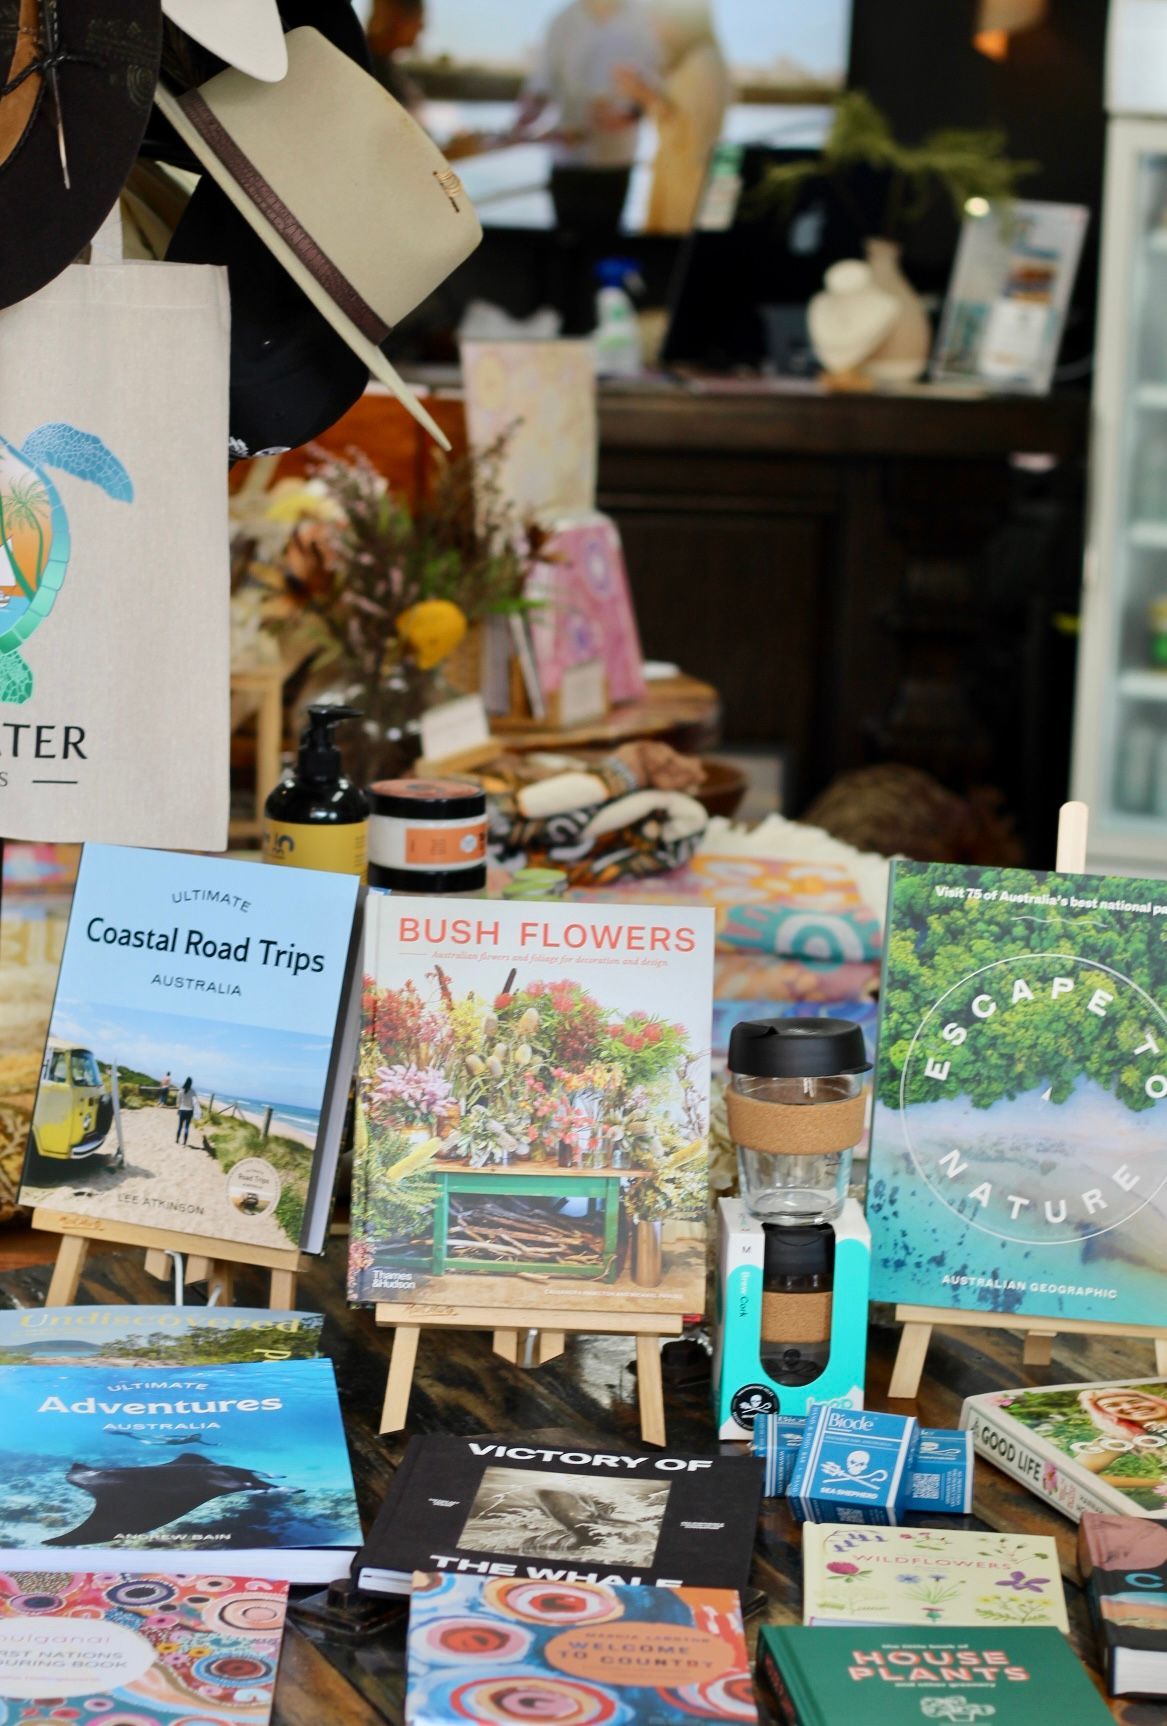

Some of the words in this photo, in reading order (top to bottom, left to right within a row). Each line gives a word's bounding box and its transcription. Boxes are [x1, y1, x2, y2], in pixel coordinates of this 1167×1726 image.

[0, 722, 88, 760] TER
[172, 889, 251, 913] ULTIMATE
[935, 886, 964, 898] Visit
[966, 888, 982, 899] 75
[983, 889, 998, 901] of
[999, 890, 1068, 907] Australia's
[1070, 895, 1097, 908] best
[1099, 900, 1152, 914] national
[399, 917, 499, 945] BUSH
[520, 922, 696, 952] FLOWERS
[87, 917, 178, 952] Coastal
[184, 930, 250, 962] Road
[259, 939, 325, 976] Trips
[151, 974, 242, 996] AUSTRALIA
[925, 977, 1114, 1080] ESCAPE
[1133, 1033, 1167, 1098] TO
[939, 1149, 1140, 1223] NATURE
[142, 1198, 204, 1214] ATKINSON
[372, 1270, 413, 1280] Thames
[942, 1275, 1025, 1291] AUSTRALIAN
[1030, 1283, 1118, 1299] GEOGRAPHIC
[20, 1312, 301, 1333] Undiscovered
[107, 1382, 209, 1392] ULTIMATE
[37, 1396, 283, 1414] Adventures
[103, 1422, 221, 1430] AUSTRALIA
[467, 1443, 648, 1469] VICTORY
[654, 1458, 713, 1472] OF
[982, 1426, 1015, 1462] GOOD
[1018, 1451, 1041, 1481] LIFE
[429, 1555, 518, 1577] THE
[853, 1554, 1013, 1570] WILDFLOWERS
[38, 1651, 124, 1659] NATIONS
[568, 1641, 689, 1655] WELCOME
[852, 1651, 1010, 1665] HOUSE
[71, 1661, 128, 1669] BOOK
[559, 1651, 588, 1660] TO
[600, 1656, 714, 1668] COUNTRY
[848, 1666, 1030, 1681] PLANTS
